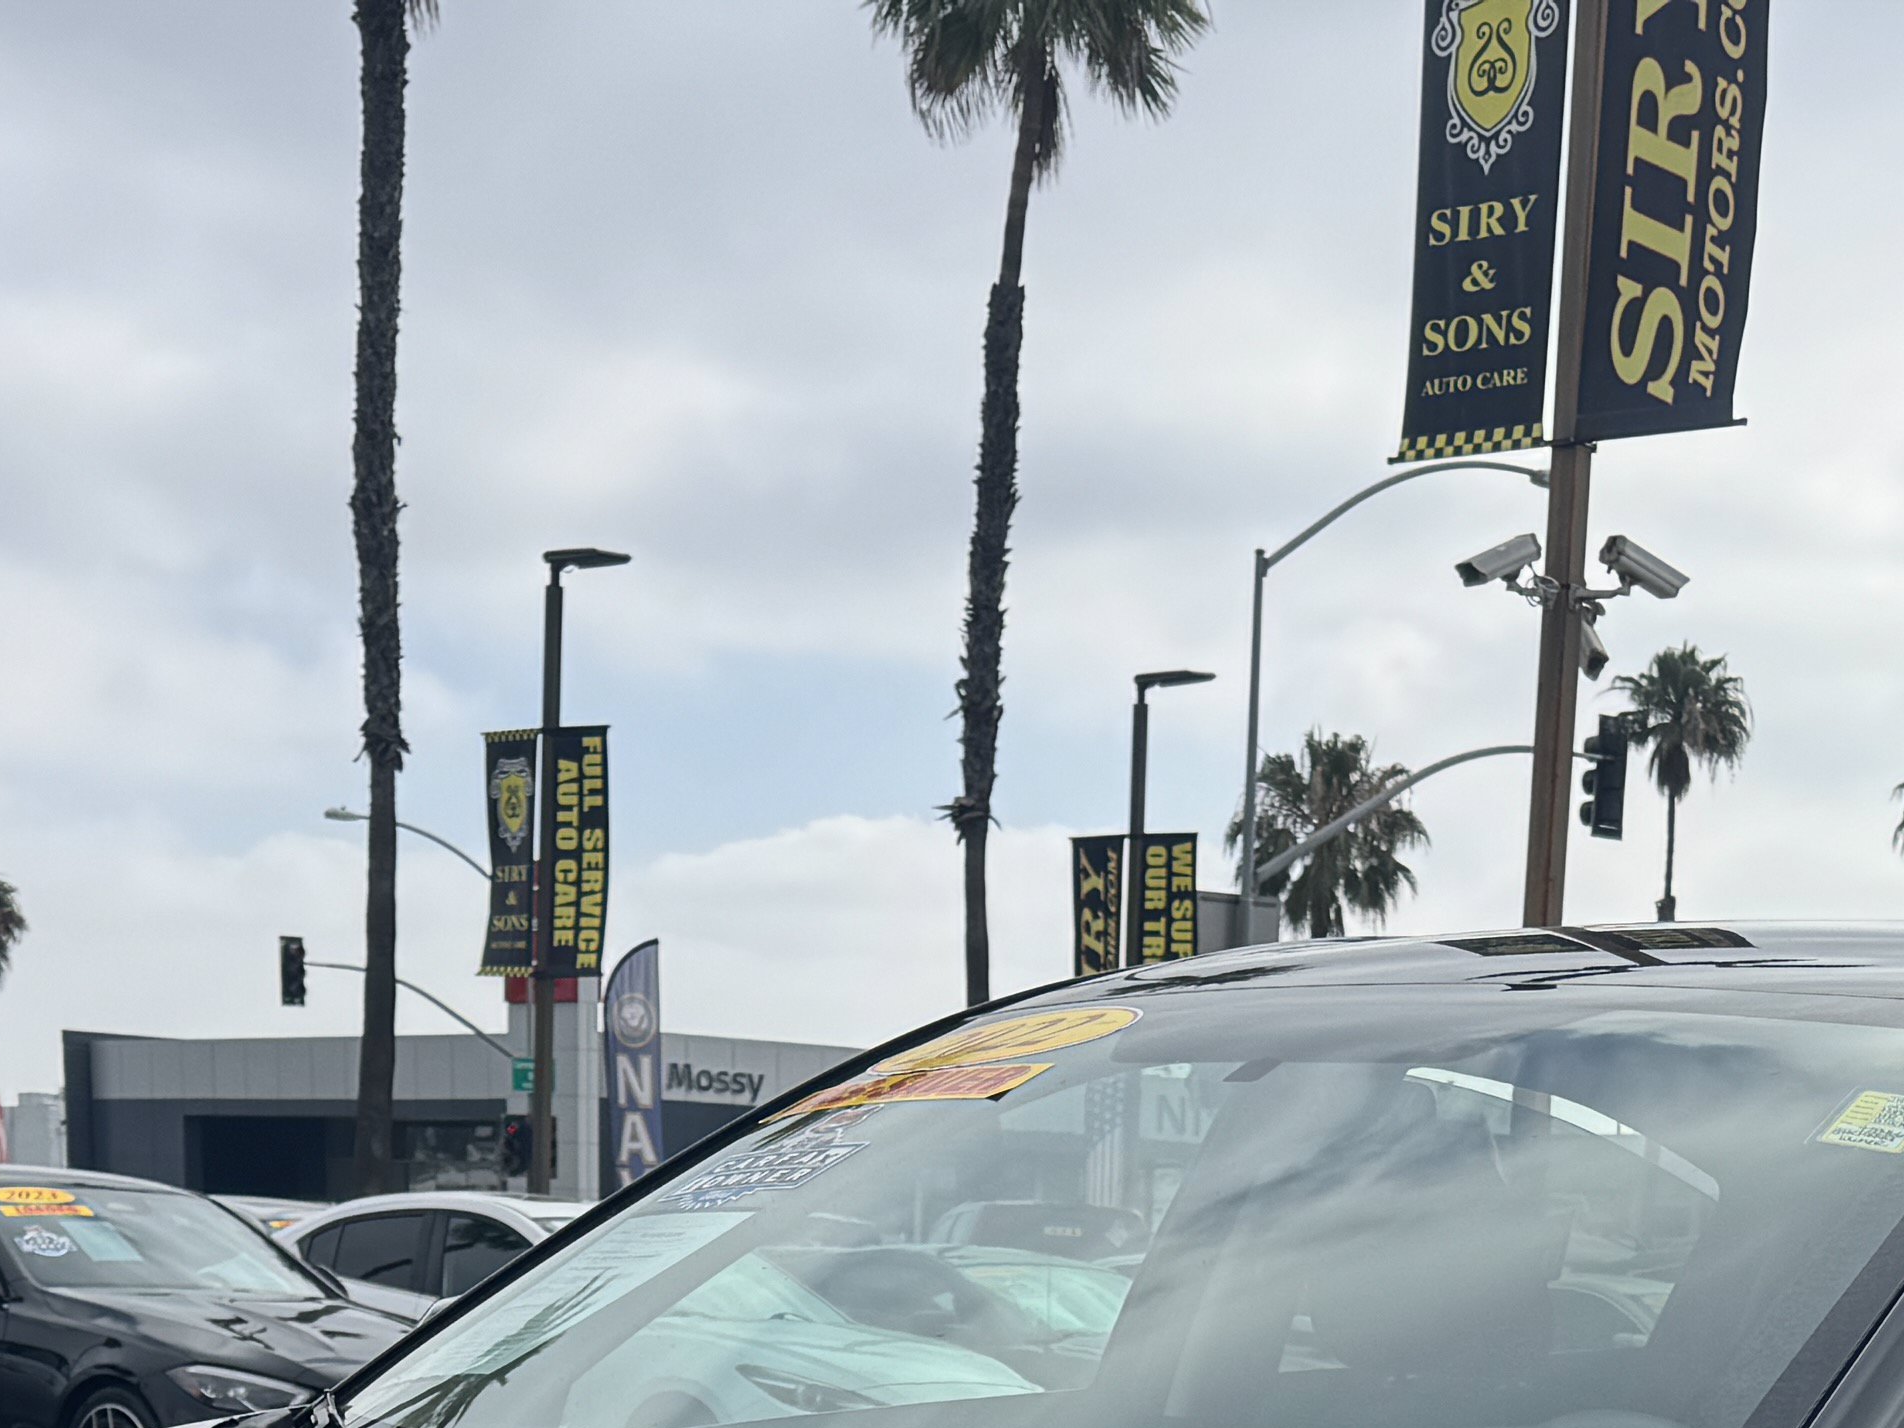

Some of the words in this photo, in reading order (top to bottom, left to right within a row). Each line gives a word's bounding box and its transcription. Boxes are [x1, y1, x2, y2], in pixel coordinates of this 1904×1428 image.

[1428, 194, 1538, 247] SIRY
[1461, 260, 1497, 292] &
[1421, 307, 1533, 357] SONS
[1421, 373, 1471, 398] AUTO
[1475, 367, 1528, 390] CARE
[580, 735, 604, 813] FULL
[556, 758, 580, 851] AUTO
[1144, 845, 1168, 911] OUR
[1171, 841, 1193, 893] WE
[490, 914, 529, 932] SONS
[552, 859, 578, 948] CARE
[576, 828, 605, 970] SERVICE
[665, 1062, 764, 1104] Mossy
